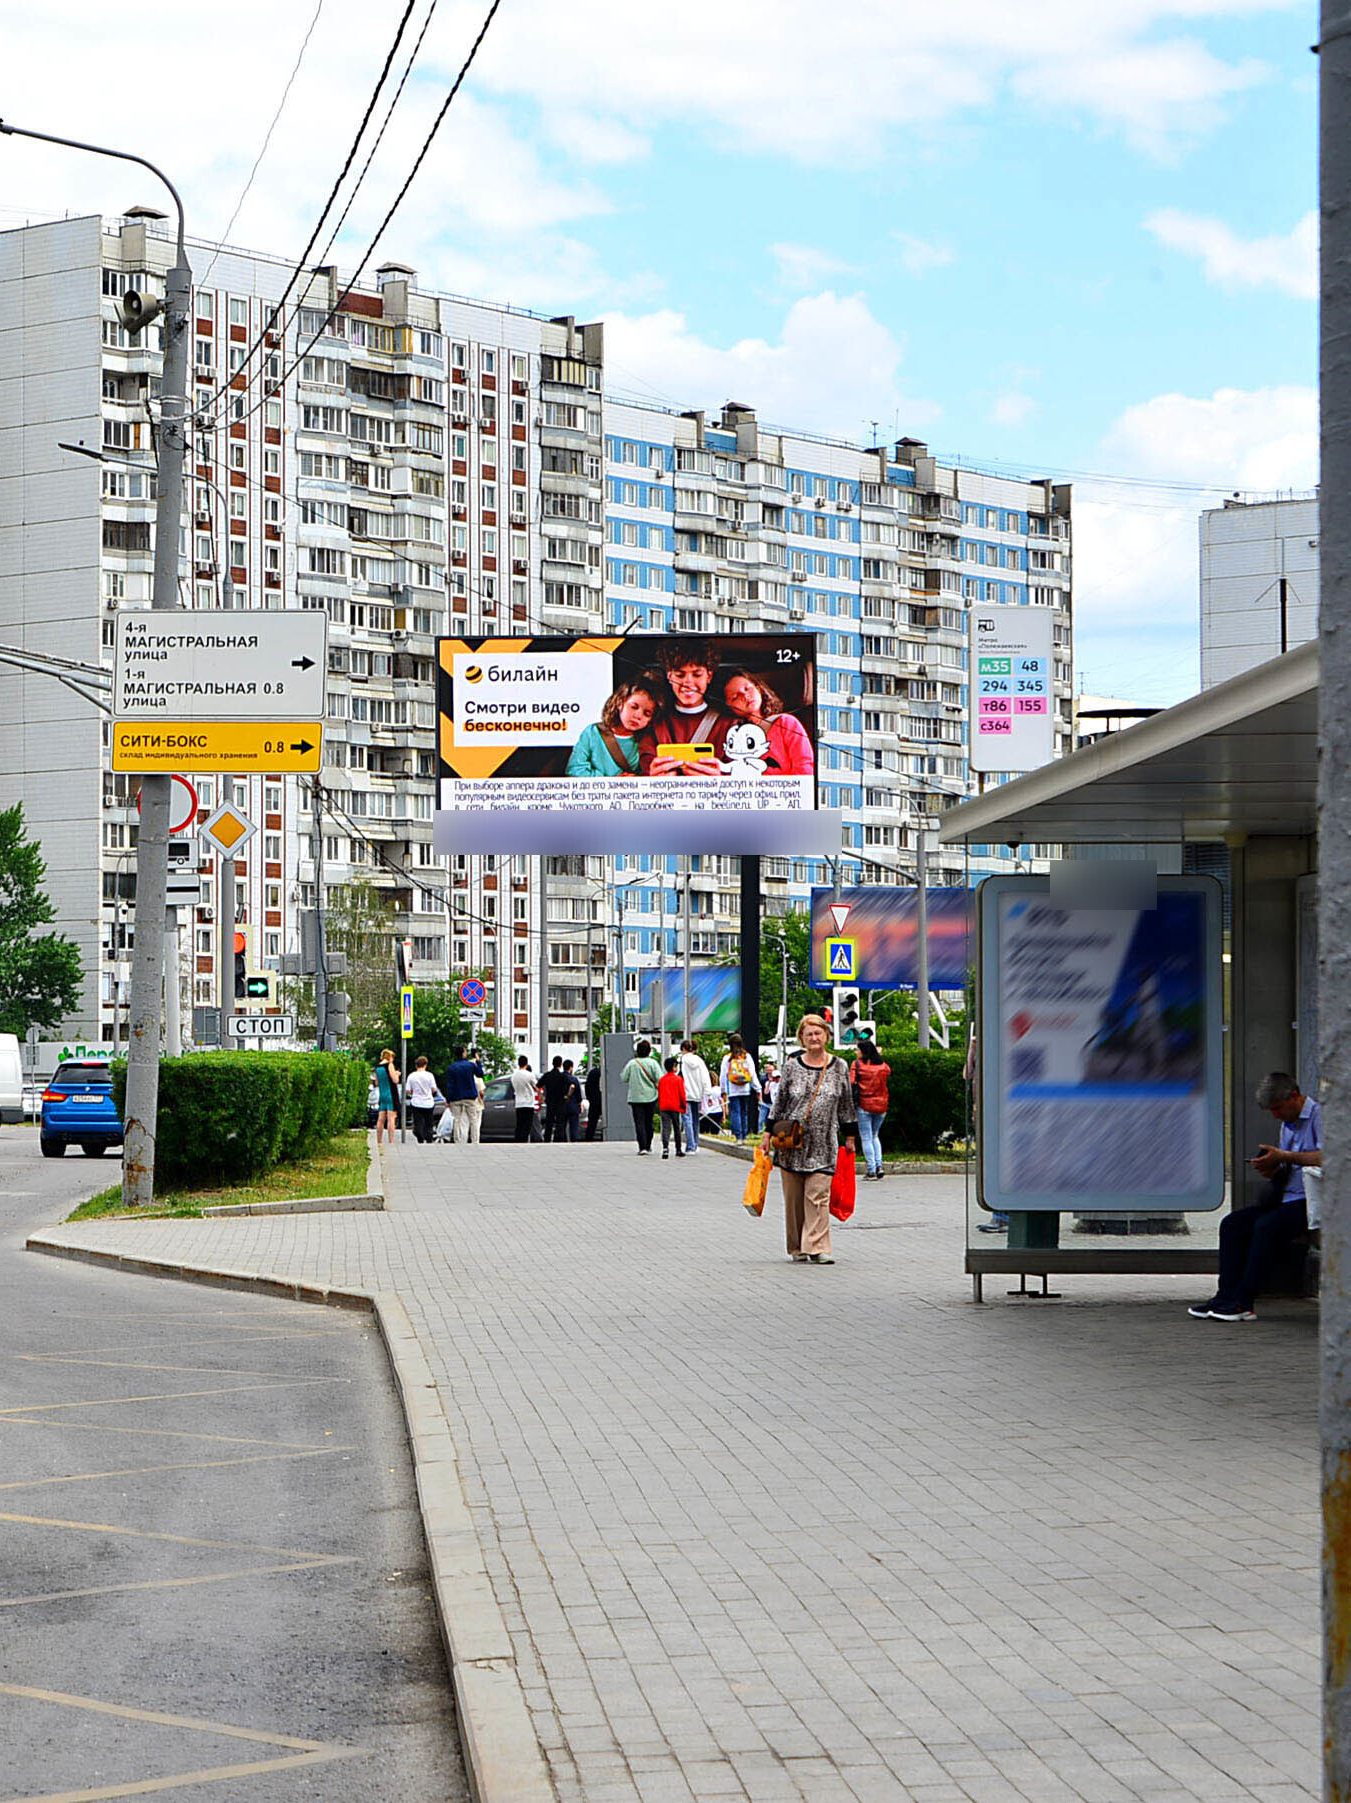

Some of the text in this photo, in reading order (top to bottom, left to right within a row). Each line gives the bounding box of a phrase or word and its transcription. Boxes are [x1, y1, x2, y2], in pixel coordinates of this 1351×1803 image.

[125, 621, 147, 633] 4-я
[125, 635, 259, 648] МАГИСТРАЛЬНАЯ
[124, 650, 168, 663] улица
[776, 648, 801, 663] 12+
[1021, 660, 1039, 672] 48
[124, 668, 146, 680] 1-я
[488, 665, 558, 682] билайн
[123, 682, 285, 695] МАГИСТРАЛЬНАЯ 0.8
[982, 680, 1008, 692] 294
[1017, 680, 1043, 692] 345
[123, 696, 167, 709] улица
[464, 700, 580, 717] Смотри видео
[982, 700, 1008, 712] т86
[1018, 700, 1042, 712] 155
[464, 718, 567, 732] бесконечно!
[980, 720, 1010, 731] с364
[120, 735, 208, 748] СИТИ-БОКС
[264, 741, 285, 753] 0.8
[119, 751, 258, 761] склад индивидуального хранения
[454, 780, 471, 792] При
[473, 780, 504, 793] выборе
[536, 781, 570, 792] дракона
[572, 782, 578, 790] и
[579, 781, 591, 791] до
[592, 781, 606, 790] его
[607, 781, 638, 790] замены
[649, 778, 718, 791] неограниченный
[720, 779, 747, 790] доступ
[755, 780, 801, 790] некоторым
[454, 793, 505, 804] популярным
[507, 792, 570, 803] видеосервисам
[571, 790, 586, 800] без
[587, 792, 611, 802] траты
[613, 791, 640, 800] пакета
[641, 791, 684, 801] интернета
[685, 791, 696, 799] по
[697, 790, 727, 801] тарифу
[728, 791, 752, 800] через
[694, 802, 705, 810] на
[757, 799, 769, 809] UP
[235, 1019, 285, 1034] СТОП
